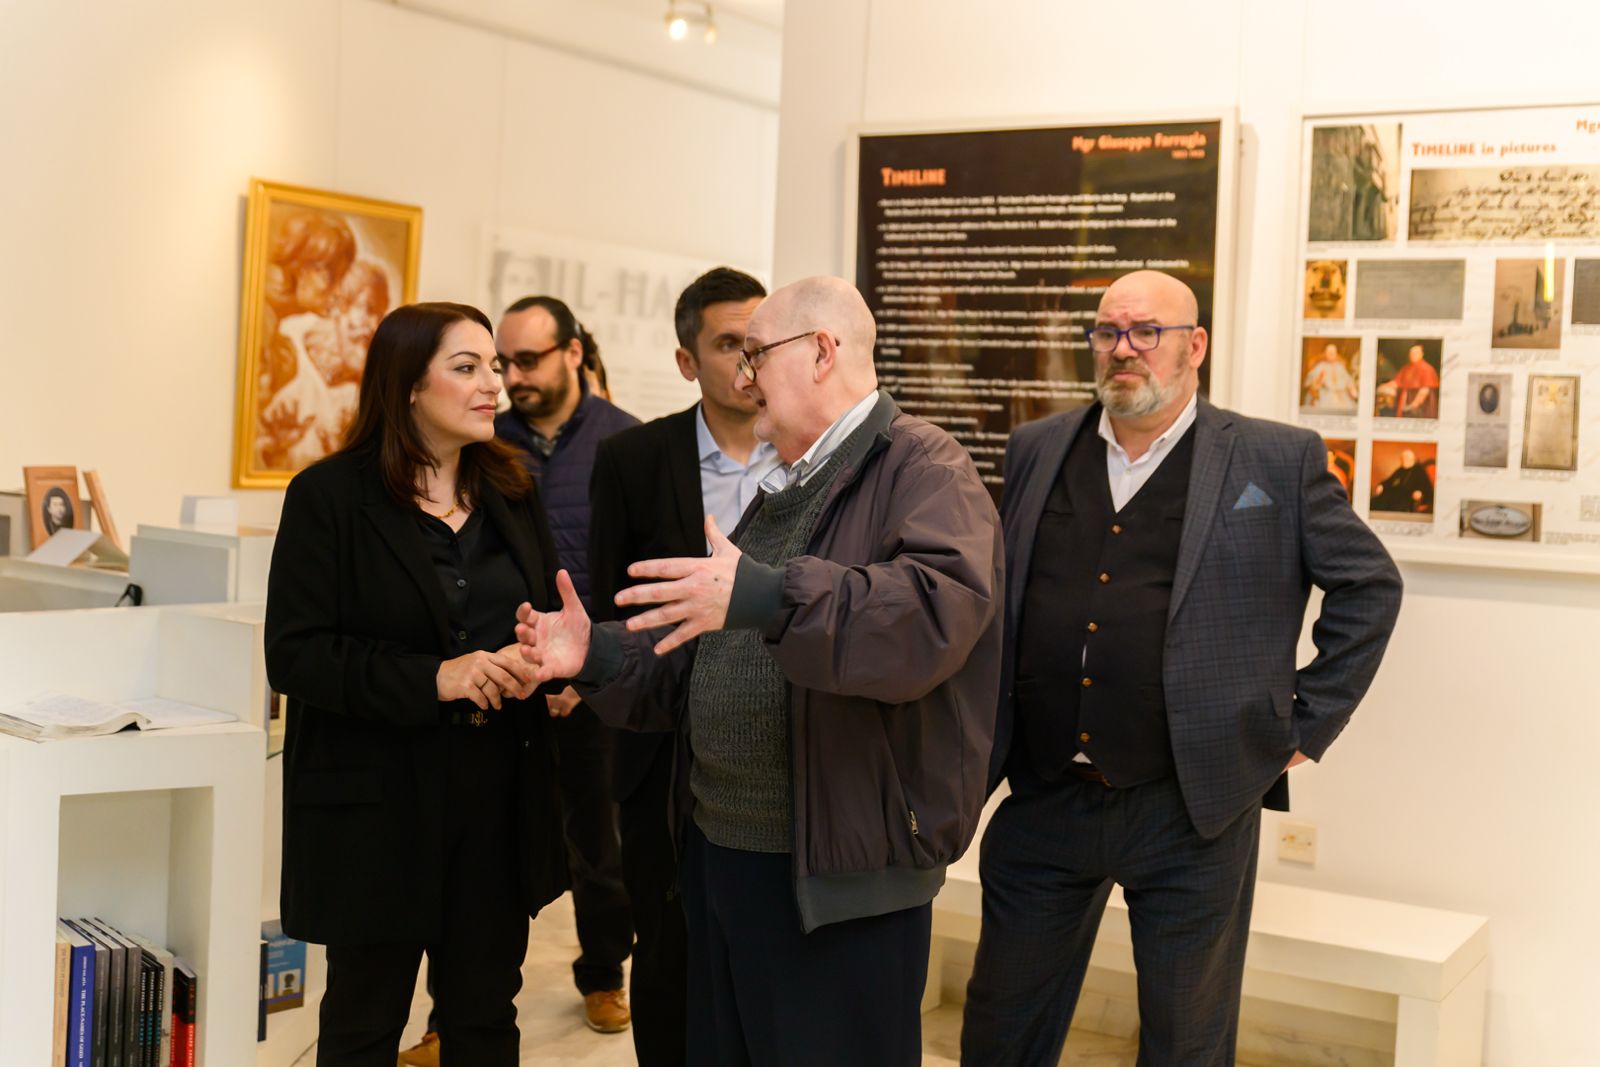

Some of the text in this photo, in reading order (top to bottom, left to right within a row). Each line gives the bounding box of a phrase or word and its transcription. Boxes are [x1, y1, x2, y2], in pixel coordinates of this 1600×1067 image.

[1412, 141, 1557, 157] TIMELINE in pictures
[881, 167, 946, 186] TIMELINE
